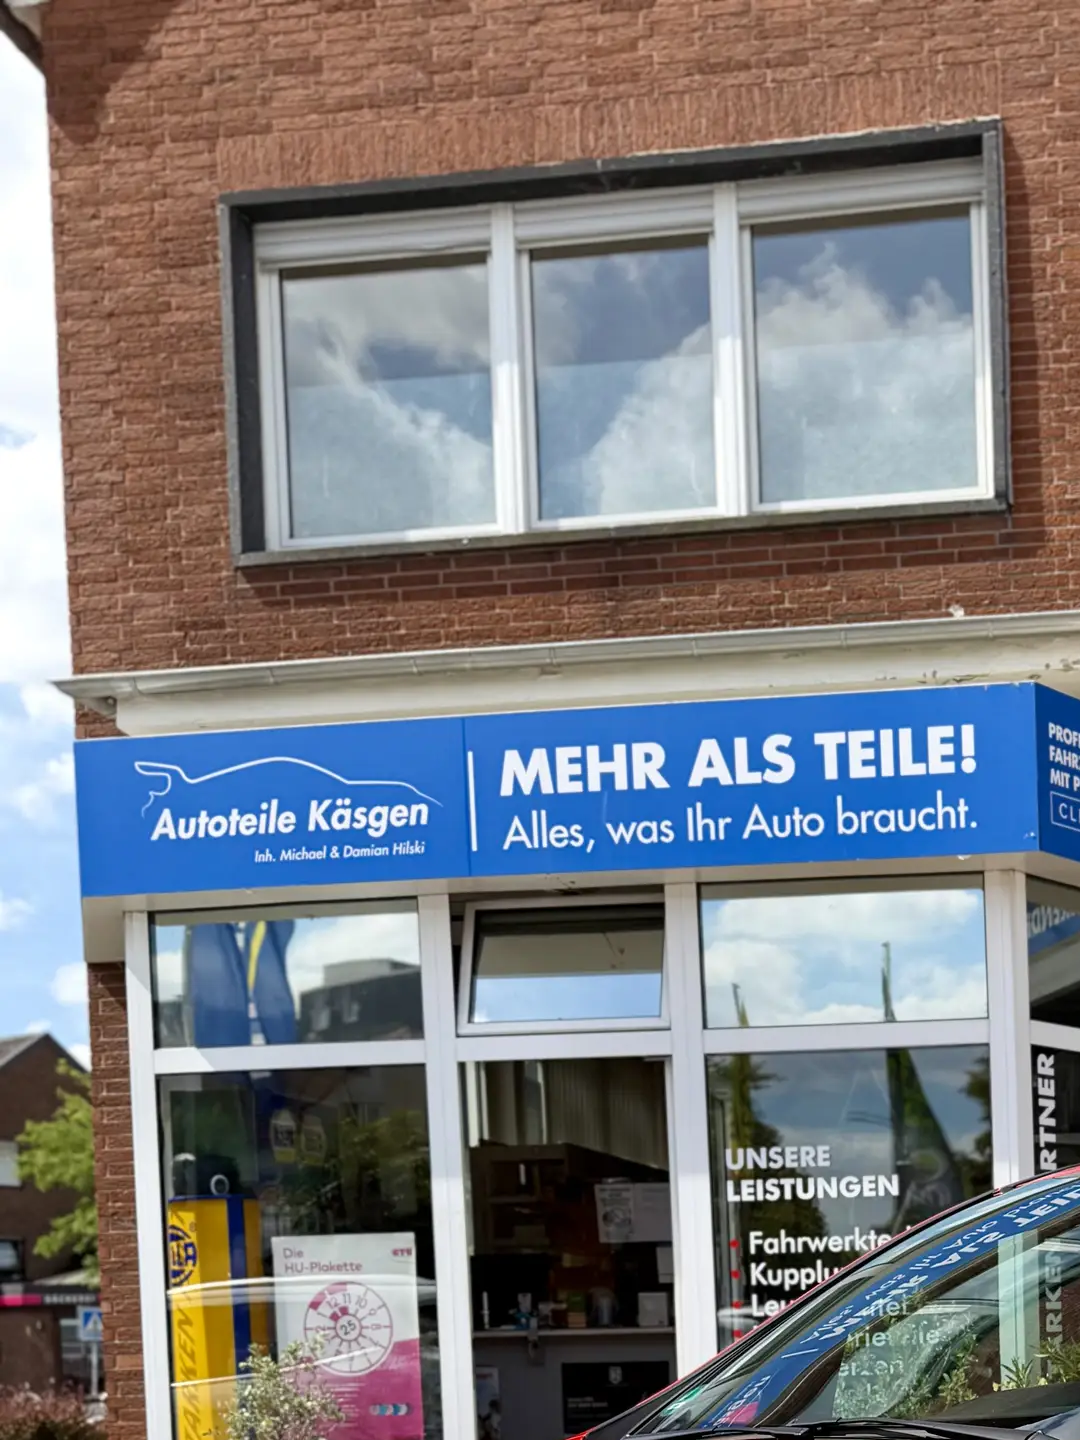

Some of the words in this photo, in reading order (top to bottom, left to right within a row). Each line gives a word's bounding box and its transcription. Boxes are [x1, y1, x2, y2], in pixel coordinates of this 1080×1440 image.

[500, 743, 669, 796] MEHR
[688, 734, 795, 786] ALS
[814, 725, 976, 779] TEILE!
[1050, 768, 1071, 789] MIT
[151, 799, 297, 841] Autoteile
[307, 797, 429, 838] Käsgen
[503, 809, 594, 852] Alles,
[606, 820, 675, 845] was
[687, 802, 732, 842] Ihr
[743, 804, 825, 839] Auto
[836, 789, 977, 835] braucht.
[254, 848, 276, 863] Inh.
[279, 845, 327, 861] Michael
[330, 844, 341, 860] &
[342, 841, 389, 859] Damian
[392, 840, 425, 856] Hilski
[1037, 1052, 1057, 1171] RTNER
[725, 1145, 831, 1170] UNSERE
[726, 1174, 899, 1202] LEISTUNGEN
[282, 1247, 304, 1259] Die
[749, 1226, 908, 1255] Fahrwerkte
[284, 1261, 363, 1274] HU-Plakette
